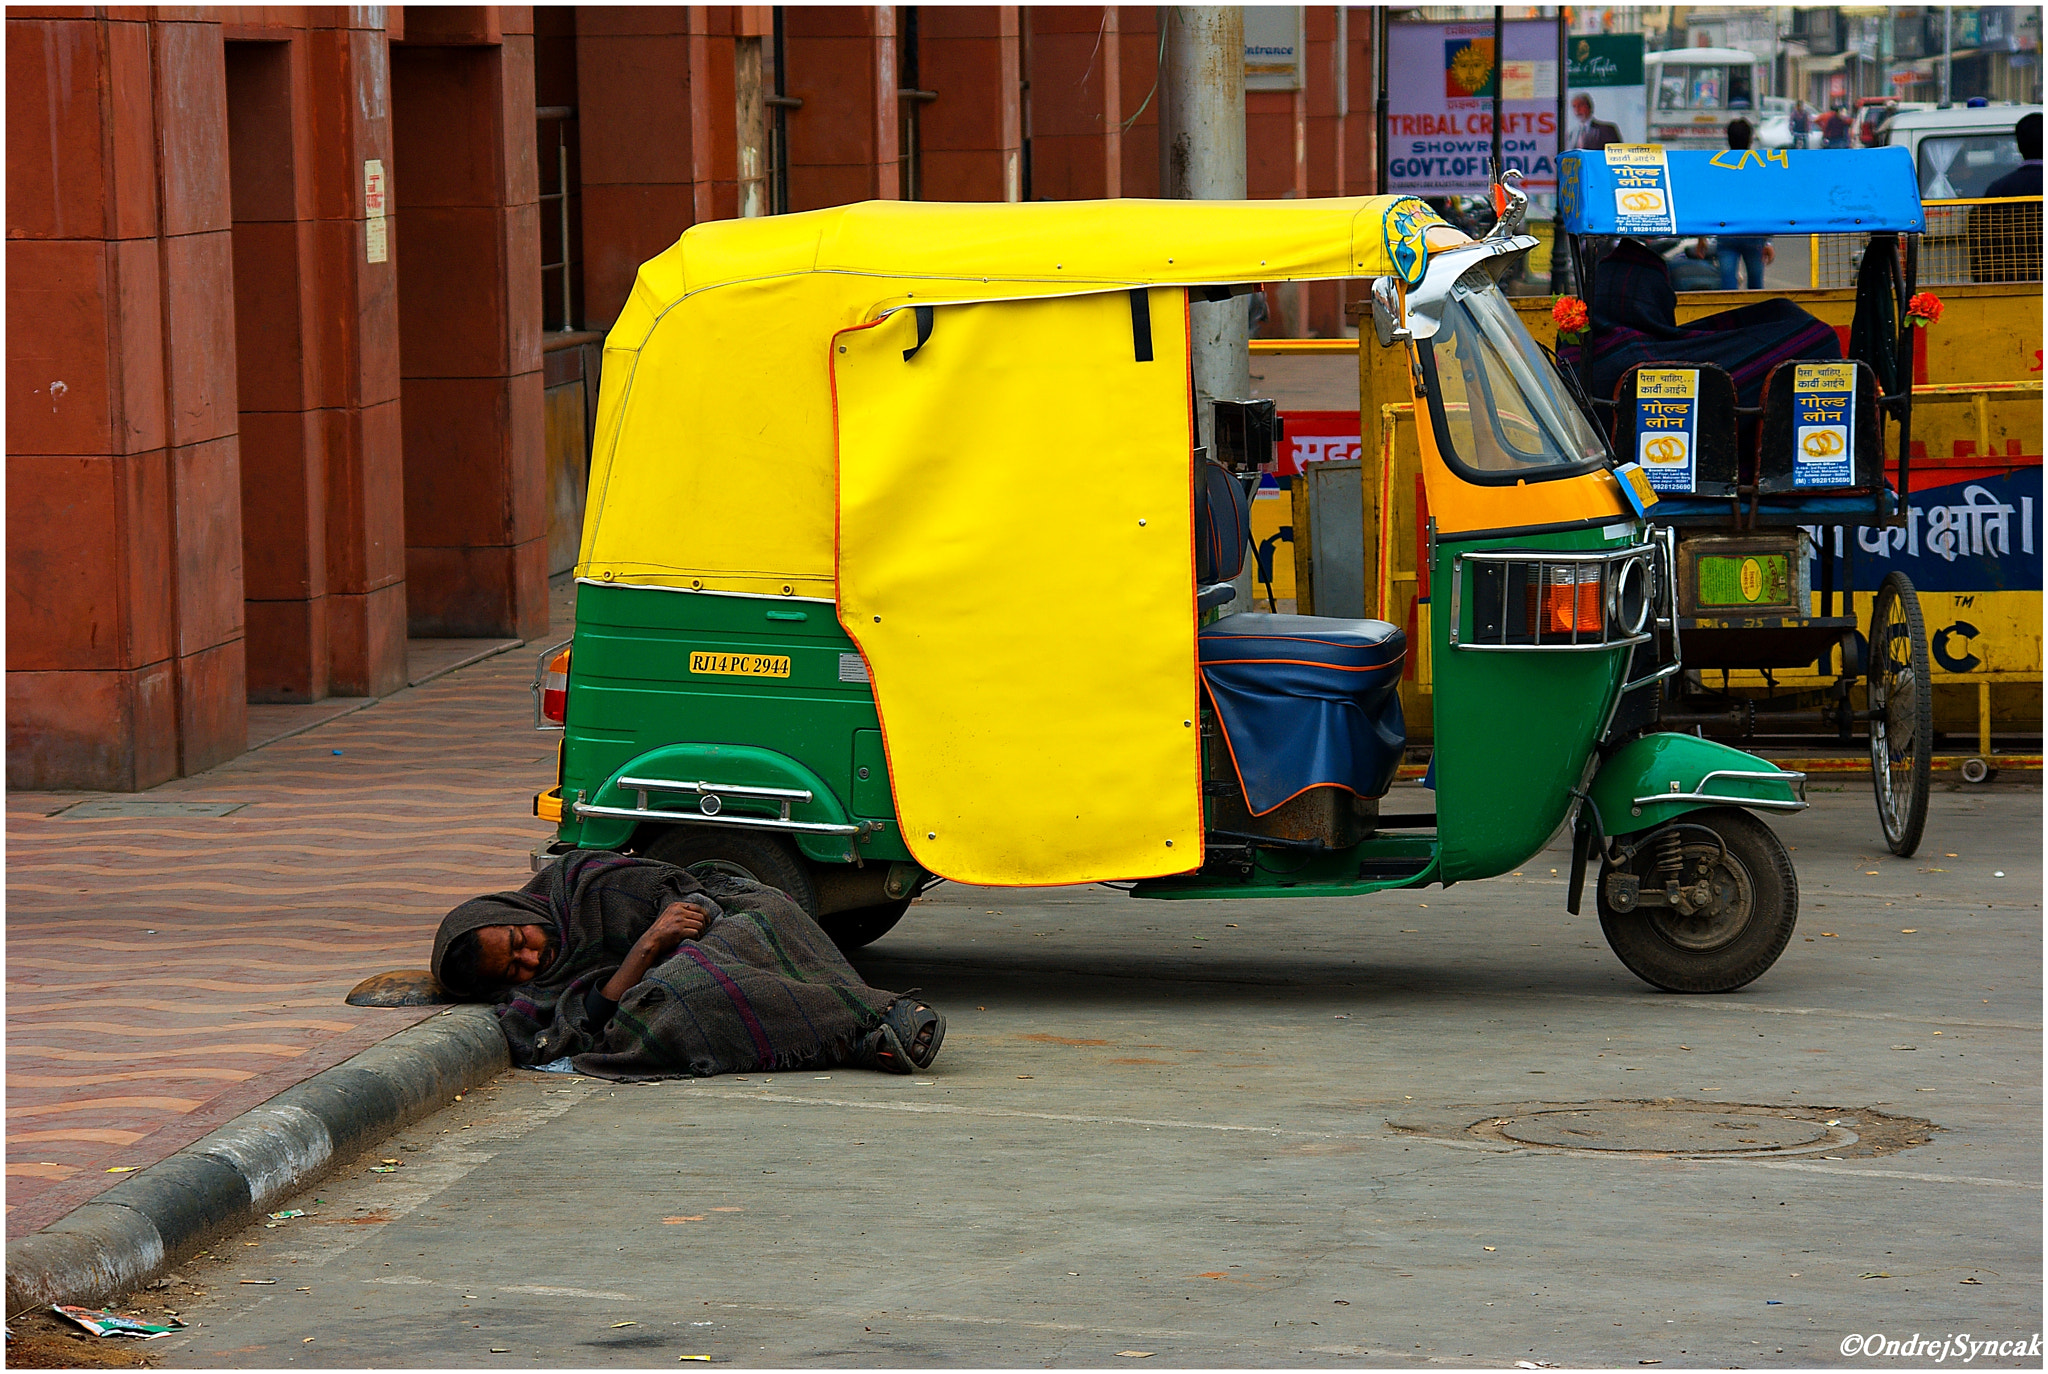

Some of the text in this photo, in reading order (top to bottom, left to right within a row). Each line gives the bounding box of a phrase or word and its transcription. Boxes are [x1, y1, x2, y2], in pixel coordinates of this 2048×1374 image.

[1388, 114, 1462, 136] TRIBAL
[1612, 166, 1661, 176] गोल्ड
[1618, 176, 1658, 186] लोन
[1641, 400, 1690, 414] गोल्ड
[1798, 394, 1848, 408] गोल्ड
[1645, 414, 1686, 428] लोन
[1803, 408, 1843, 422] लोन
[1954, 595, 1975, 609] TM
[692, 655, 789, 674] RJ14 PC 2944
